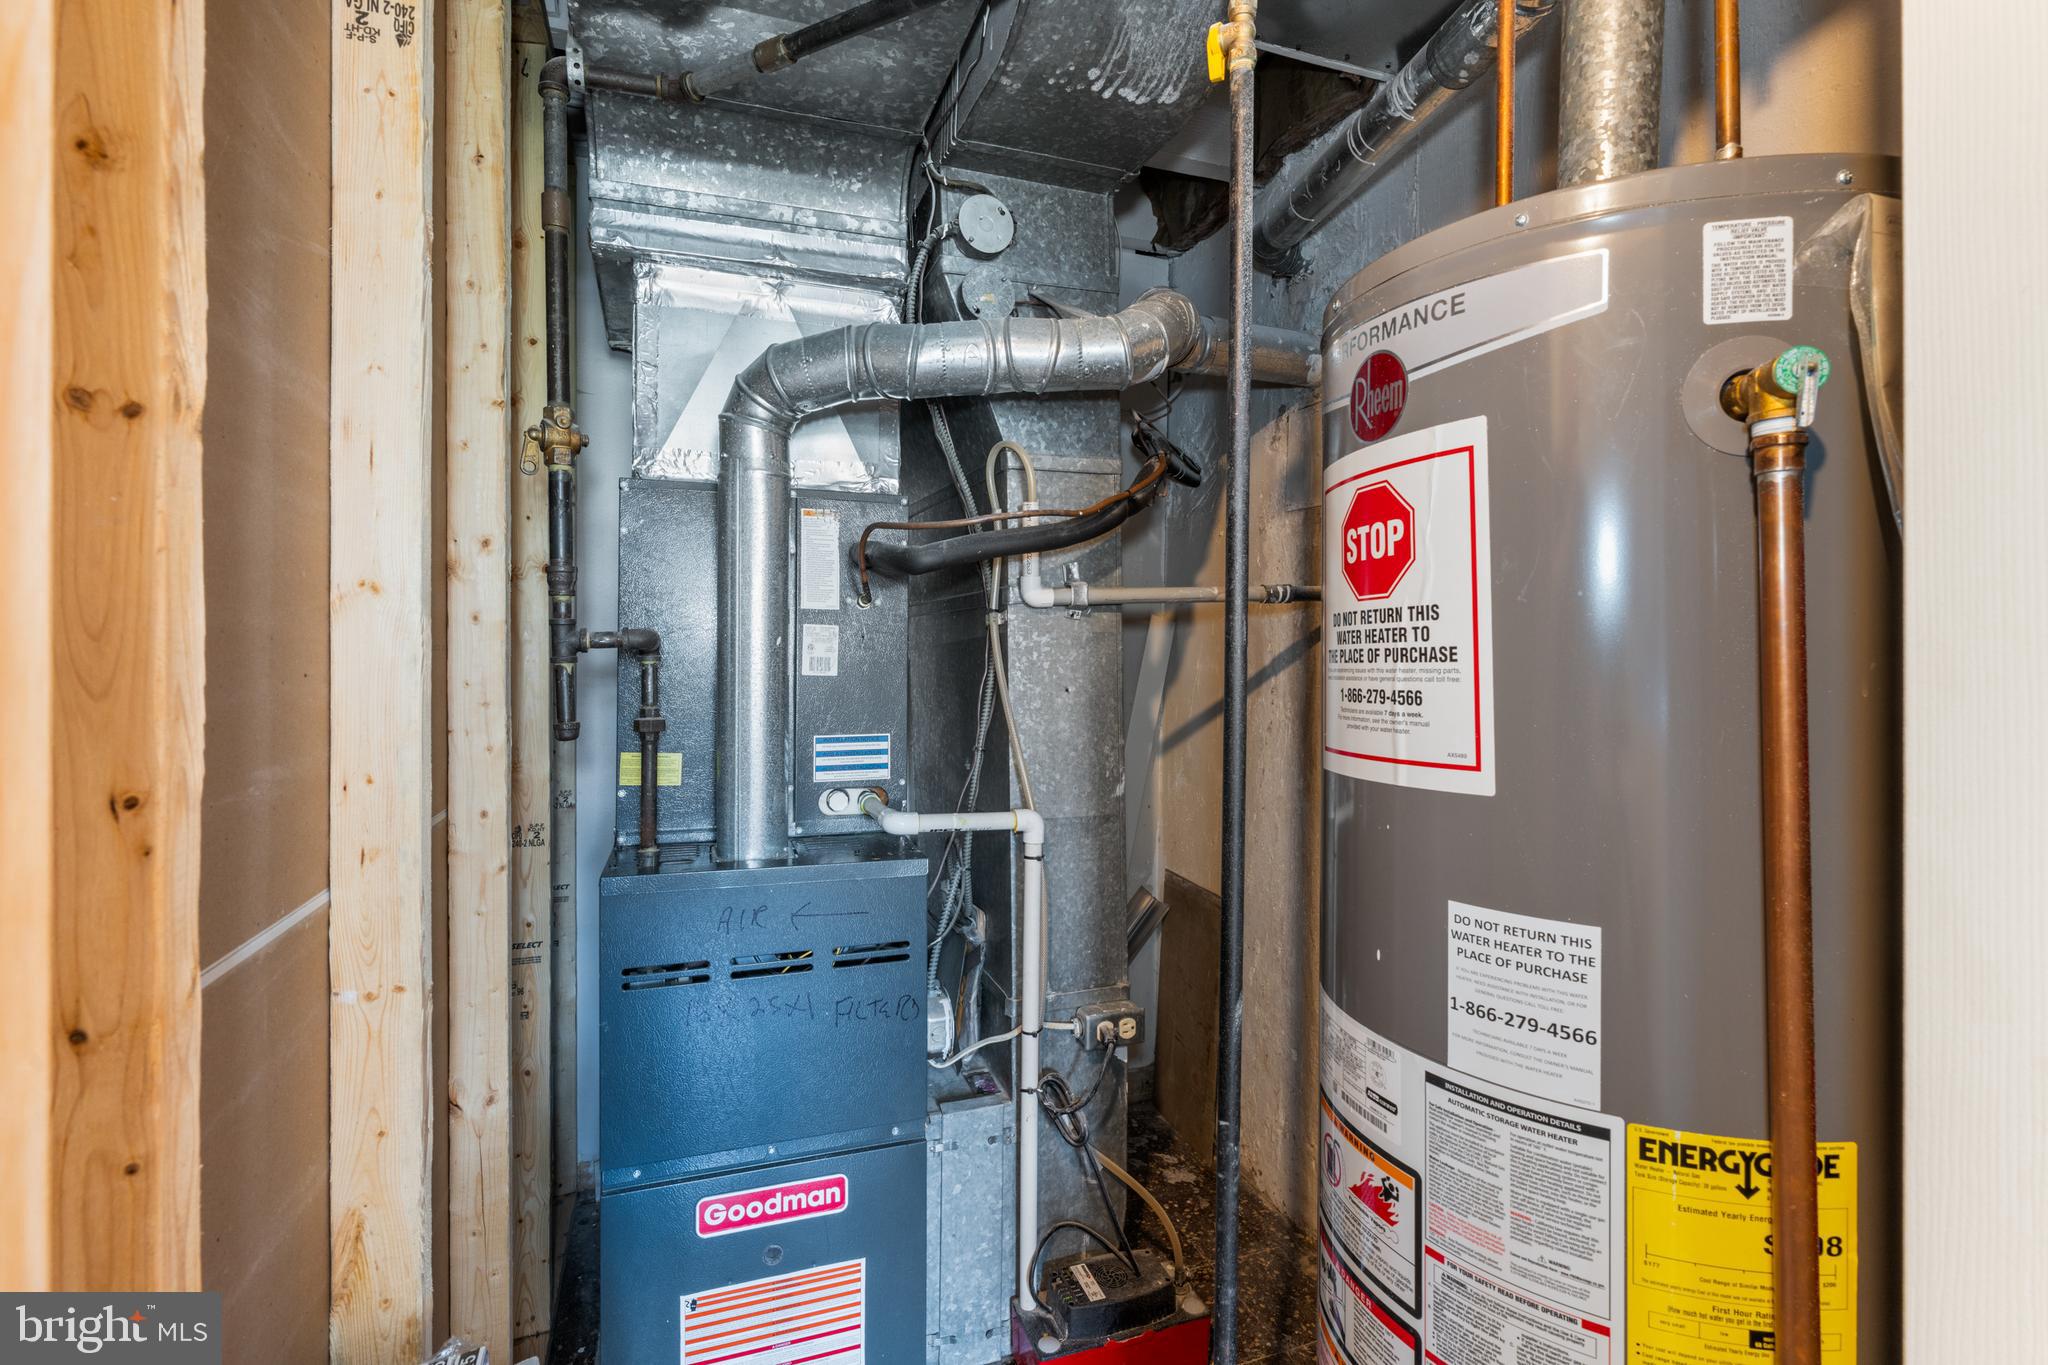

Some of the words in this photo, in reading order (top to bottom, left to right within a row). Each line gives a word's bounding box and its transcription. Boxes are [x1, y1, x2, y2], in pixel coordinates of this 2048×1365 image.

[355, 11, 369, 26] 2
[1341, 292, 1467, 359] RFORMANCE
[1354, 356, 1403, 432] Rheem
[1346, 518, 1405, 565] STOP
[1342, 611, 1358, 627] NOT
[1360, 607, 1402, 625] RETURN
[1408, 604, 1440, 621] THIS
[1336, 630, 1361, 645] WATER
[1364, 627, 1407, 644] HEATER
[1411, 626, 1430, 642] TO
[1340, 649, 1364, 664] PLACE
[1367, 648, 1380, 663] OF
[1384, 646, 1459, 663] PURCHASE
[1419, 667, 1442, 675] missing
[1340, 687, 1424, 707] 1-866-279-4566
[533, 831, 541, 839] 2
[717, 904, 769, 936] AIR
[1453, 913, 1471, 927] DO
[1474, 918, 1500, 933] NOT
[1503, 924, 1557, 945] RETURN
[1560, 934, 1592, 950] THIS
[512, 940, 543, 950] SELECT
[1450, 928, 1490, 948] WATER
[1494, 939, 1542, 960] HEATER
[1545, 949, 1565, 963] TO
[1567, 953, 1596, 969] THE
[1456, 946, 1491, 966] PLACE
[1494, 956, 1512, 969] OF
[1515, 962, 1589, 985] PURCHASE
[1514, 981, 1540, 991] PROBLEMS
[1449, 995, 1599, 1046] 1-866-279-4566
[1444, 1082, 1490, 1105] INSTALLATION
[1490, 1098, 1506, 1111] AND
[1506, 1103, 1550, 1124] OPERATION
[1549, 1118, 1582, 1133] DETAILS
[1447, 1096, 1485, 1118] AUTOMATIC
[1486, 1111, 1520, 1129] STORAGE
[1520, 1124, 1546, 1138] WATER
[1547, 1131, 1578, 1147] HEATER
[1338, 1122, 1375, 1163] WARNING
[703, 1186, 842, 1226] Goodman
[1677, 1203, 1719, 1219] Estimated
[1720, 1207, 1747, 1223] Yearly
[1748, 1211, 1774, 1225] Energ
[1340, 1268, 1373, 1310] DANGER
[1446, 1259, 1458, 1273] FOR
[1459, 1266, 1475, 1281] YOUR
[1474, 1273, 1497, 1292] SAFETY
[1496, 1286, 1514, 1301] READ
[1514, 1294, 1540, 1311] BEFORE
[1540, 1302, 1579, 1326] OPERATING
[1712, 1279, 1730, 1288] Range
[1739, 1282, 1758, 1291] Similar
[1682, 1309, 1698, 1318] much
[1699, 1311, 1708, 1320] hot
[1709, 1314, 1725, 1322] water
[1726, 1316, 1735, 1325] you
[1736, 1318, 1745, 1327] get
[1712, 1304, 1732, 1316] First
[1733, 1308, 1753, 1319] Hour
[1719, 1330, 1729, 1338] low
[1642, 1342, 1654, 1350] Your
[1703, 1343, 1728, 1353] Estimated
